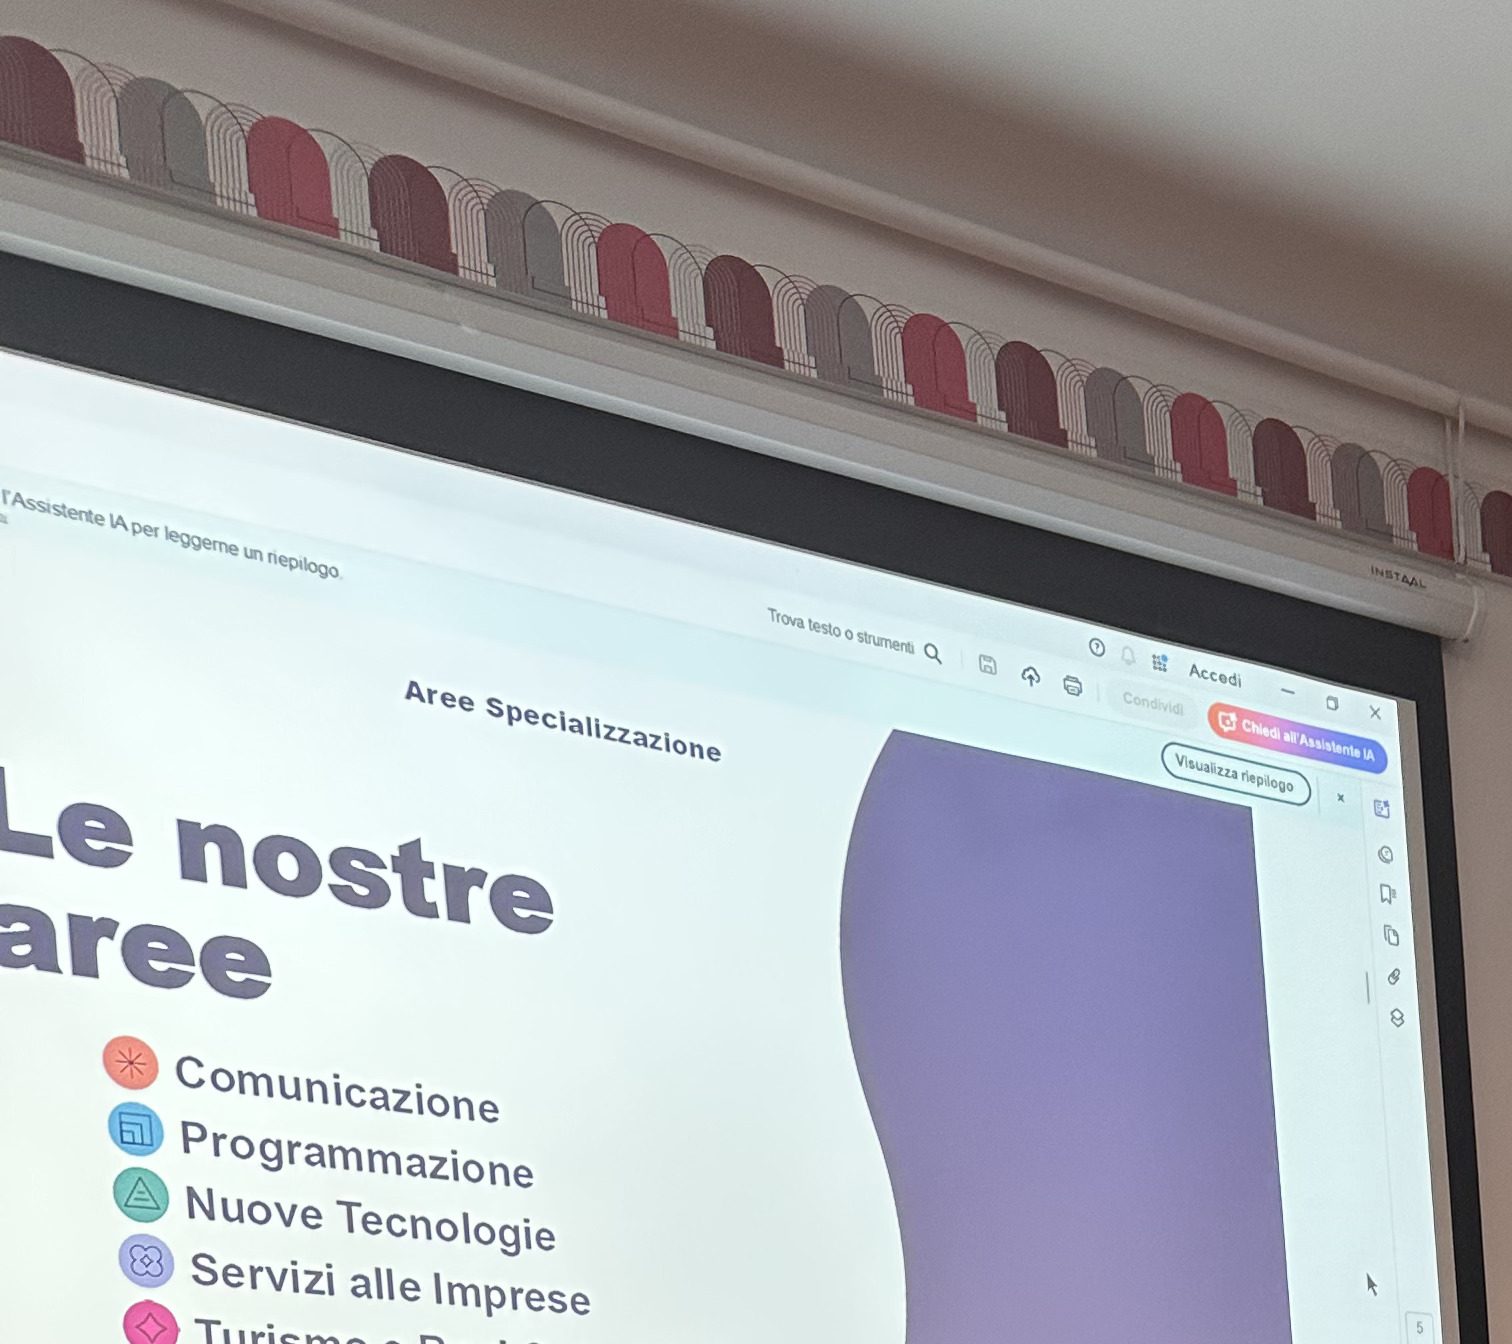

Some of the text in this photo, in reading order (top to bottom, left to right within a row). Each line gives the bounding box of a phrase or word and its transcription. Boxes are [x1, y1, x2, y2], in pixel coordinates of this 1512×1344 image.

[109, 512, 130, 532] IA
[131, 519, 160, 537] per
[164, 525, 240, 557] leggerne
[243, 545, 264, 562] un
[767, 607, 916, 655] Trova testo o strumenti
[1122, 691, 1184, 716] Condividi
[1189, 663, 1243, 688] Accedi
[404, 680, 722, 762] Aree Specializzazione
[1241, 719, 1376, 762] Chiedi all'Assistente IA
[1174, 752, 1295, 794] Visualizza riepilogo
[0, 766, 555, 935] Le nostre
[0, 902, 273, 1000] aree
[175, 1055, 501, 1124] Comunicazione
[180, 1119, 535, 1189] Programmazione
[185, 1185, 557, 1257] Nuove Tecnologie
[191, 1252, 592, 1318] Servizi alle Imprese
[1416, 1320, 1424, 1335] 5
